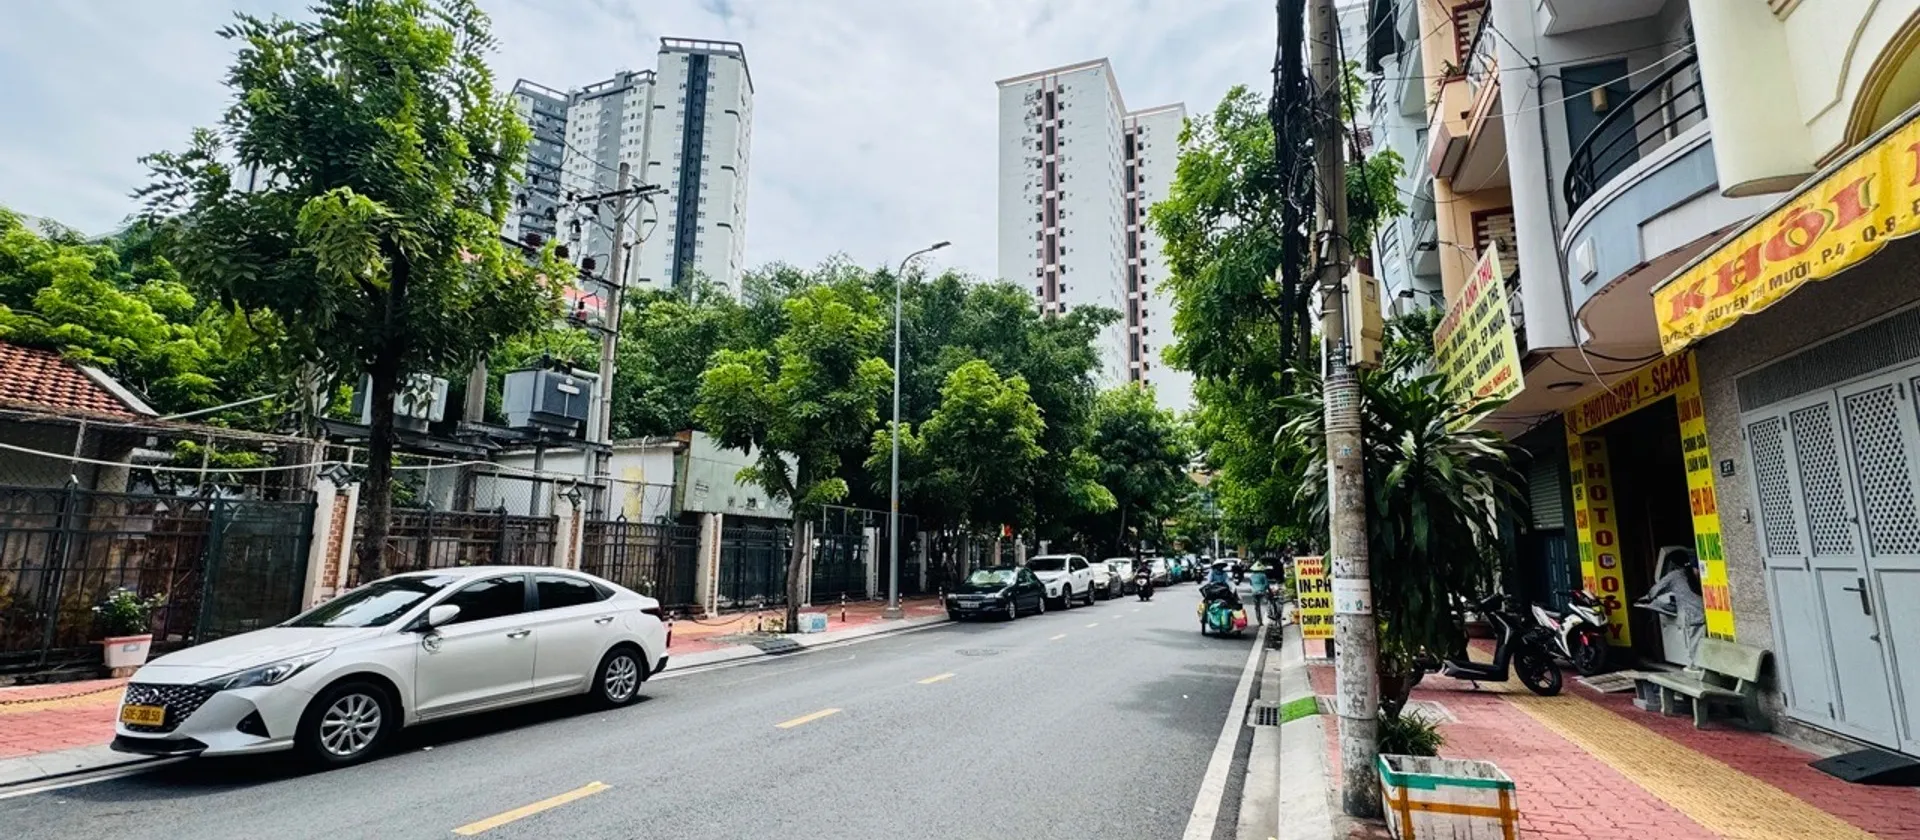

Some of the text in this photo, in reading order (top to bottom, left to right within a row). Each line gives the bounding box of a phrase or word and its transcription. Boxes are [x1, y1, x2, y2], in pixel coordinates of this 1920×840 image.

[1821, 243, 1845, 264] P.4
[1862, 216, 1896, 242] Q.8
[1583, 376, 1640, 429] PHOTOCOPY
[1651, 353, 1691, 394] SCAN
[1585, 440, 1623, 640] PHOTOCOPY
[1301, 598, 1329, 609] SCAN
